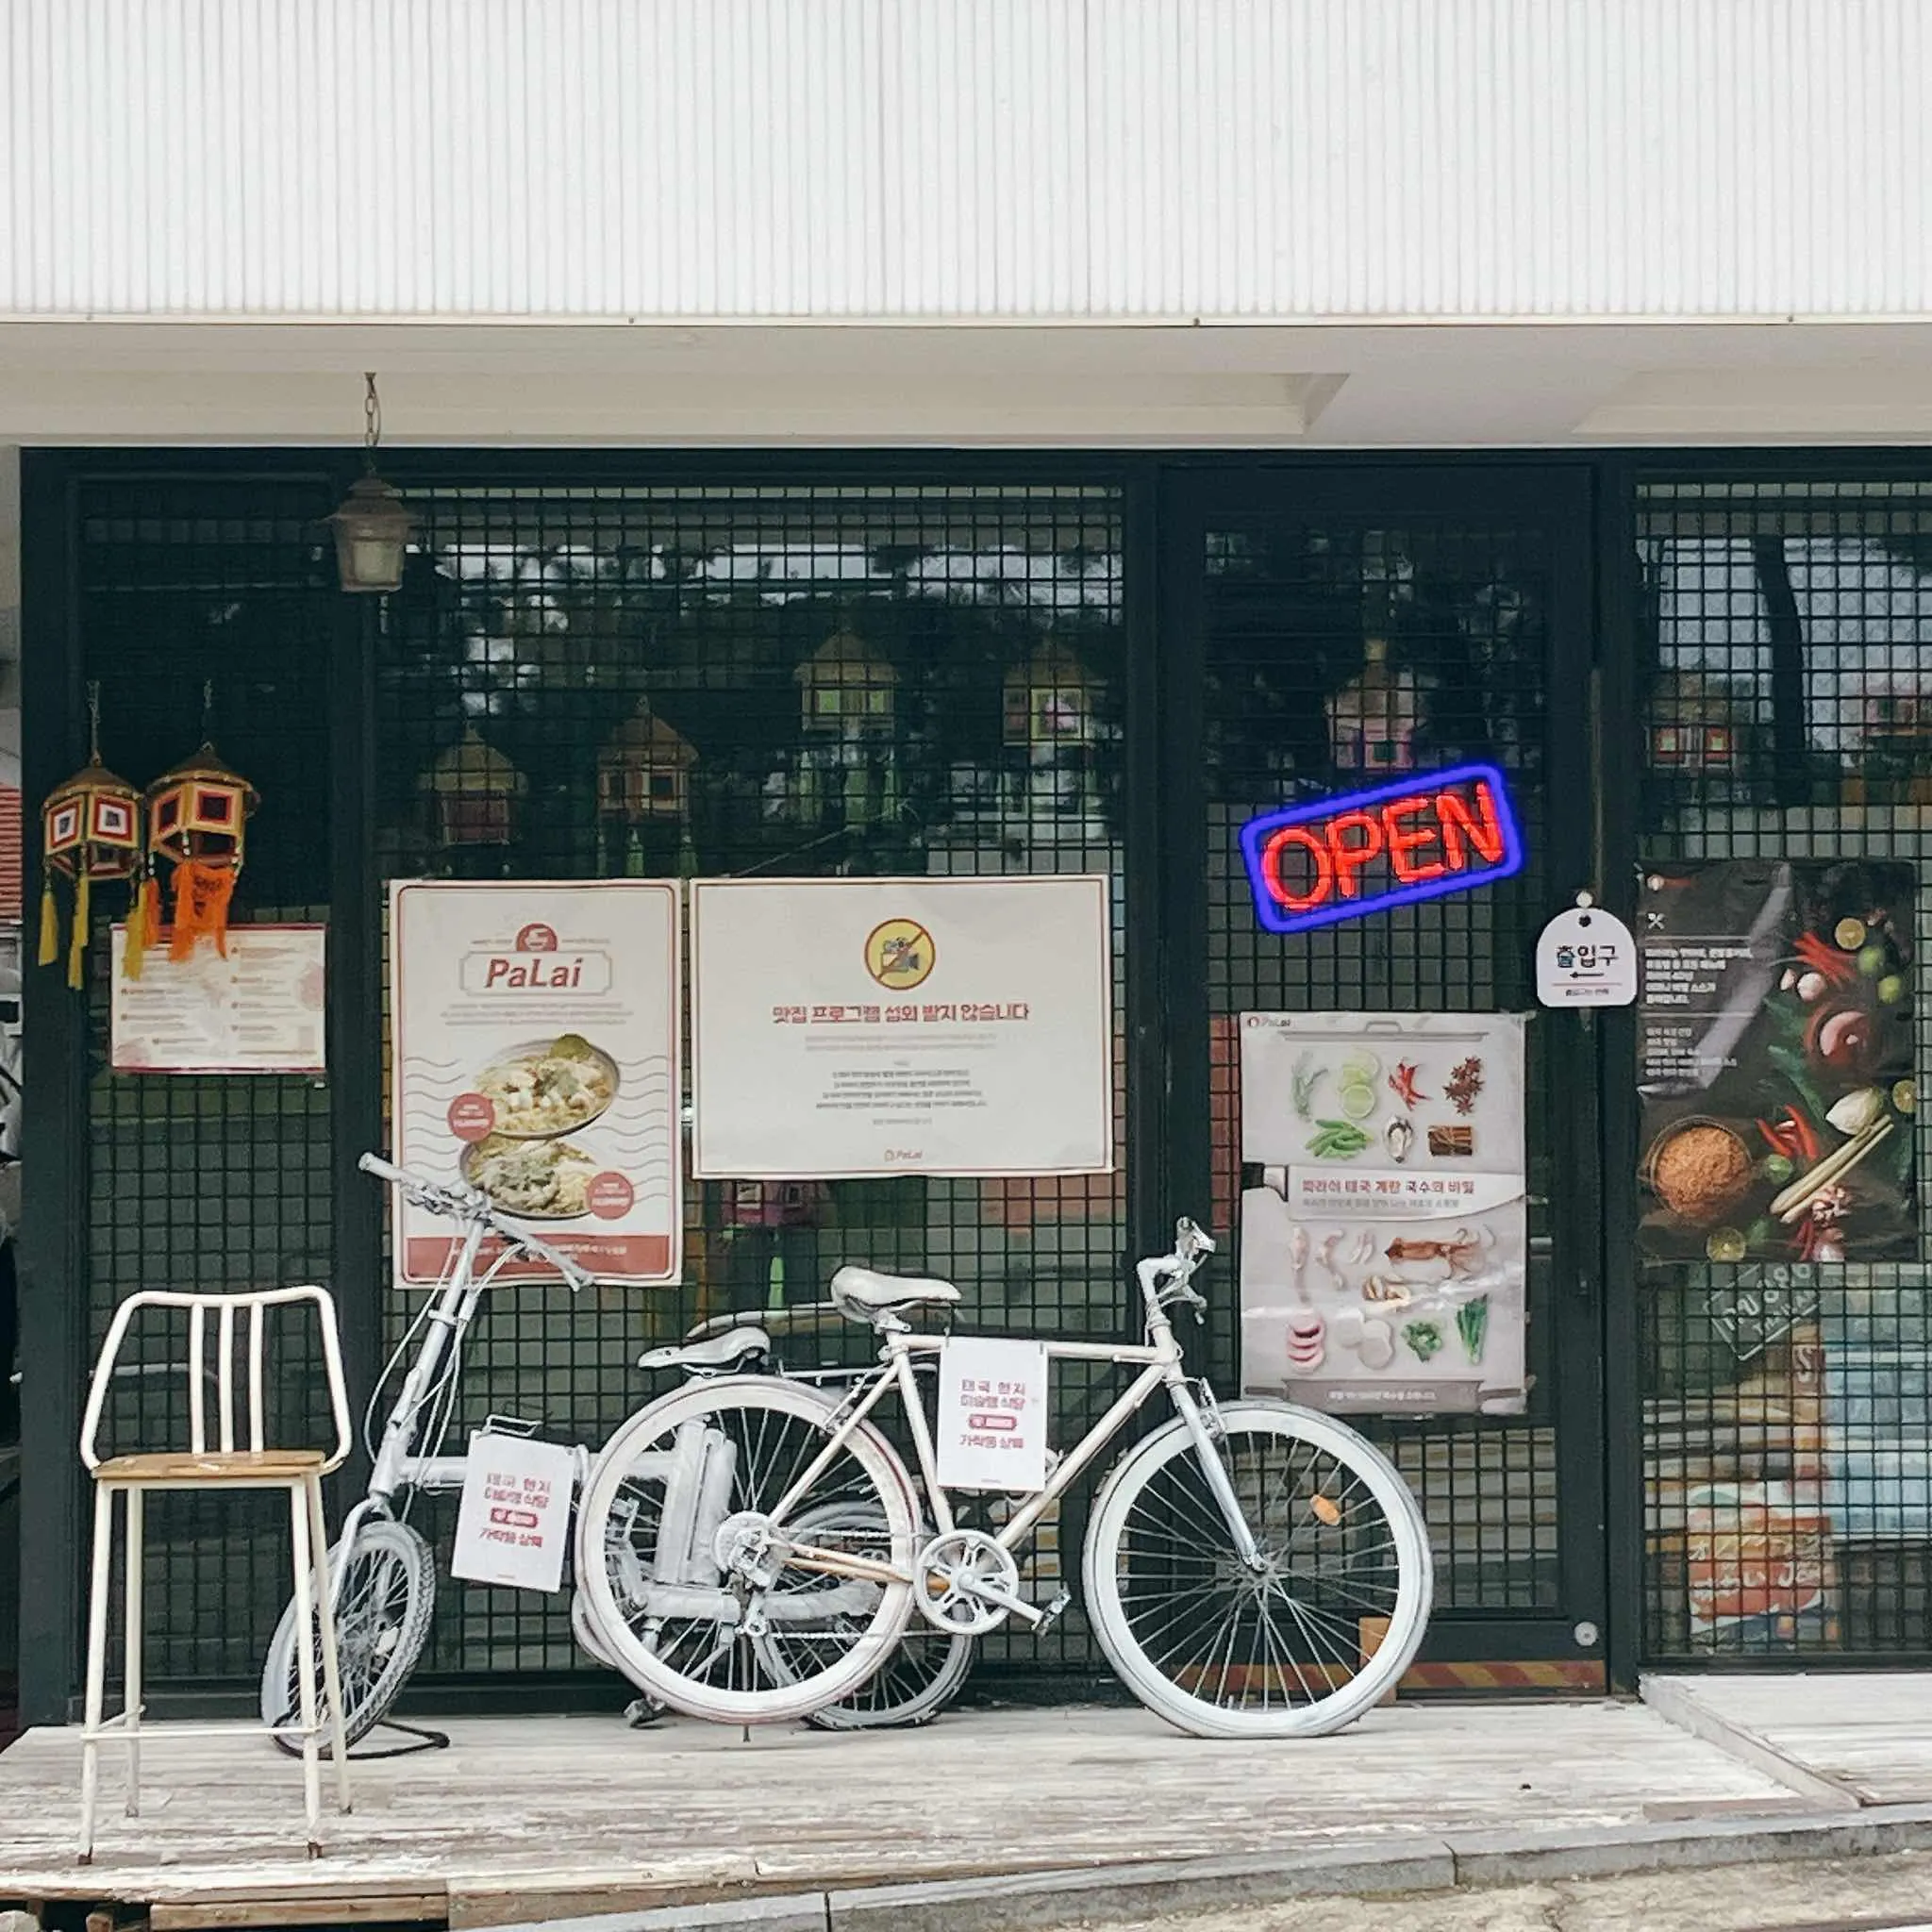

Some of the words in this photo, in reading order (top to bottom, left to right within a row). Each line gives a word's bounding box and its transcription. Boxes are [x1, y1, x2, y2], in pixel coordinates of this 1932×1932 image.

[1261, 781, 1505, 911] OPEN
[1556, 944, 1619, 969] 출입구
[485, 957, 584, 990] PaLai
[772, 1005, 808, 1024] 맛집
[810, 1005, 881, 1024] 프로그램
[884, 1005, 919, 1023] 섭외
[922, 1004, 958, 1023] 받지
[960, 1003, 1030, 1022] 않습니다
[1406, 1179, 1444, 1194] 국수의
[960, 1379, 990, 1392] 태국
[997, 1380, 1025, 1395] 현지
